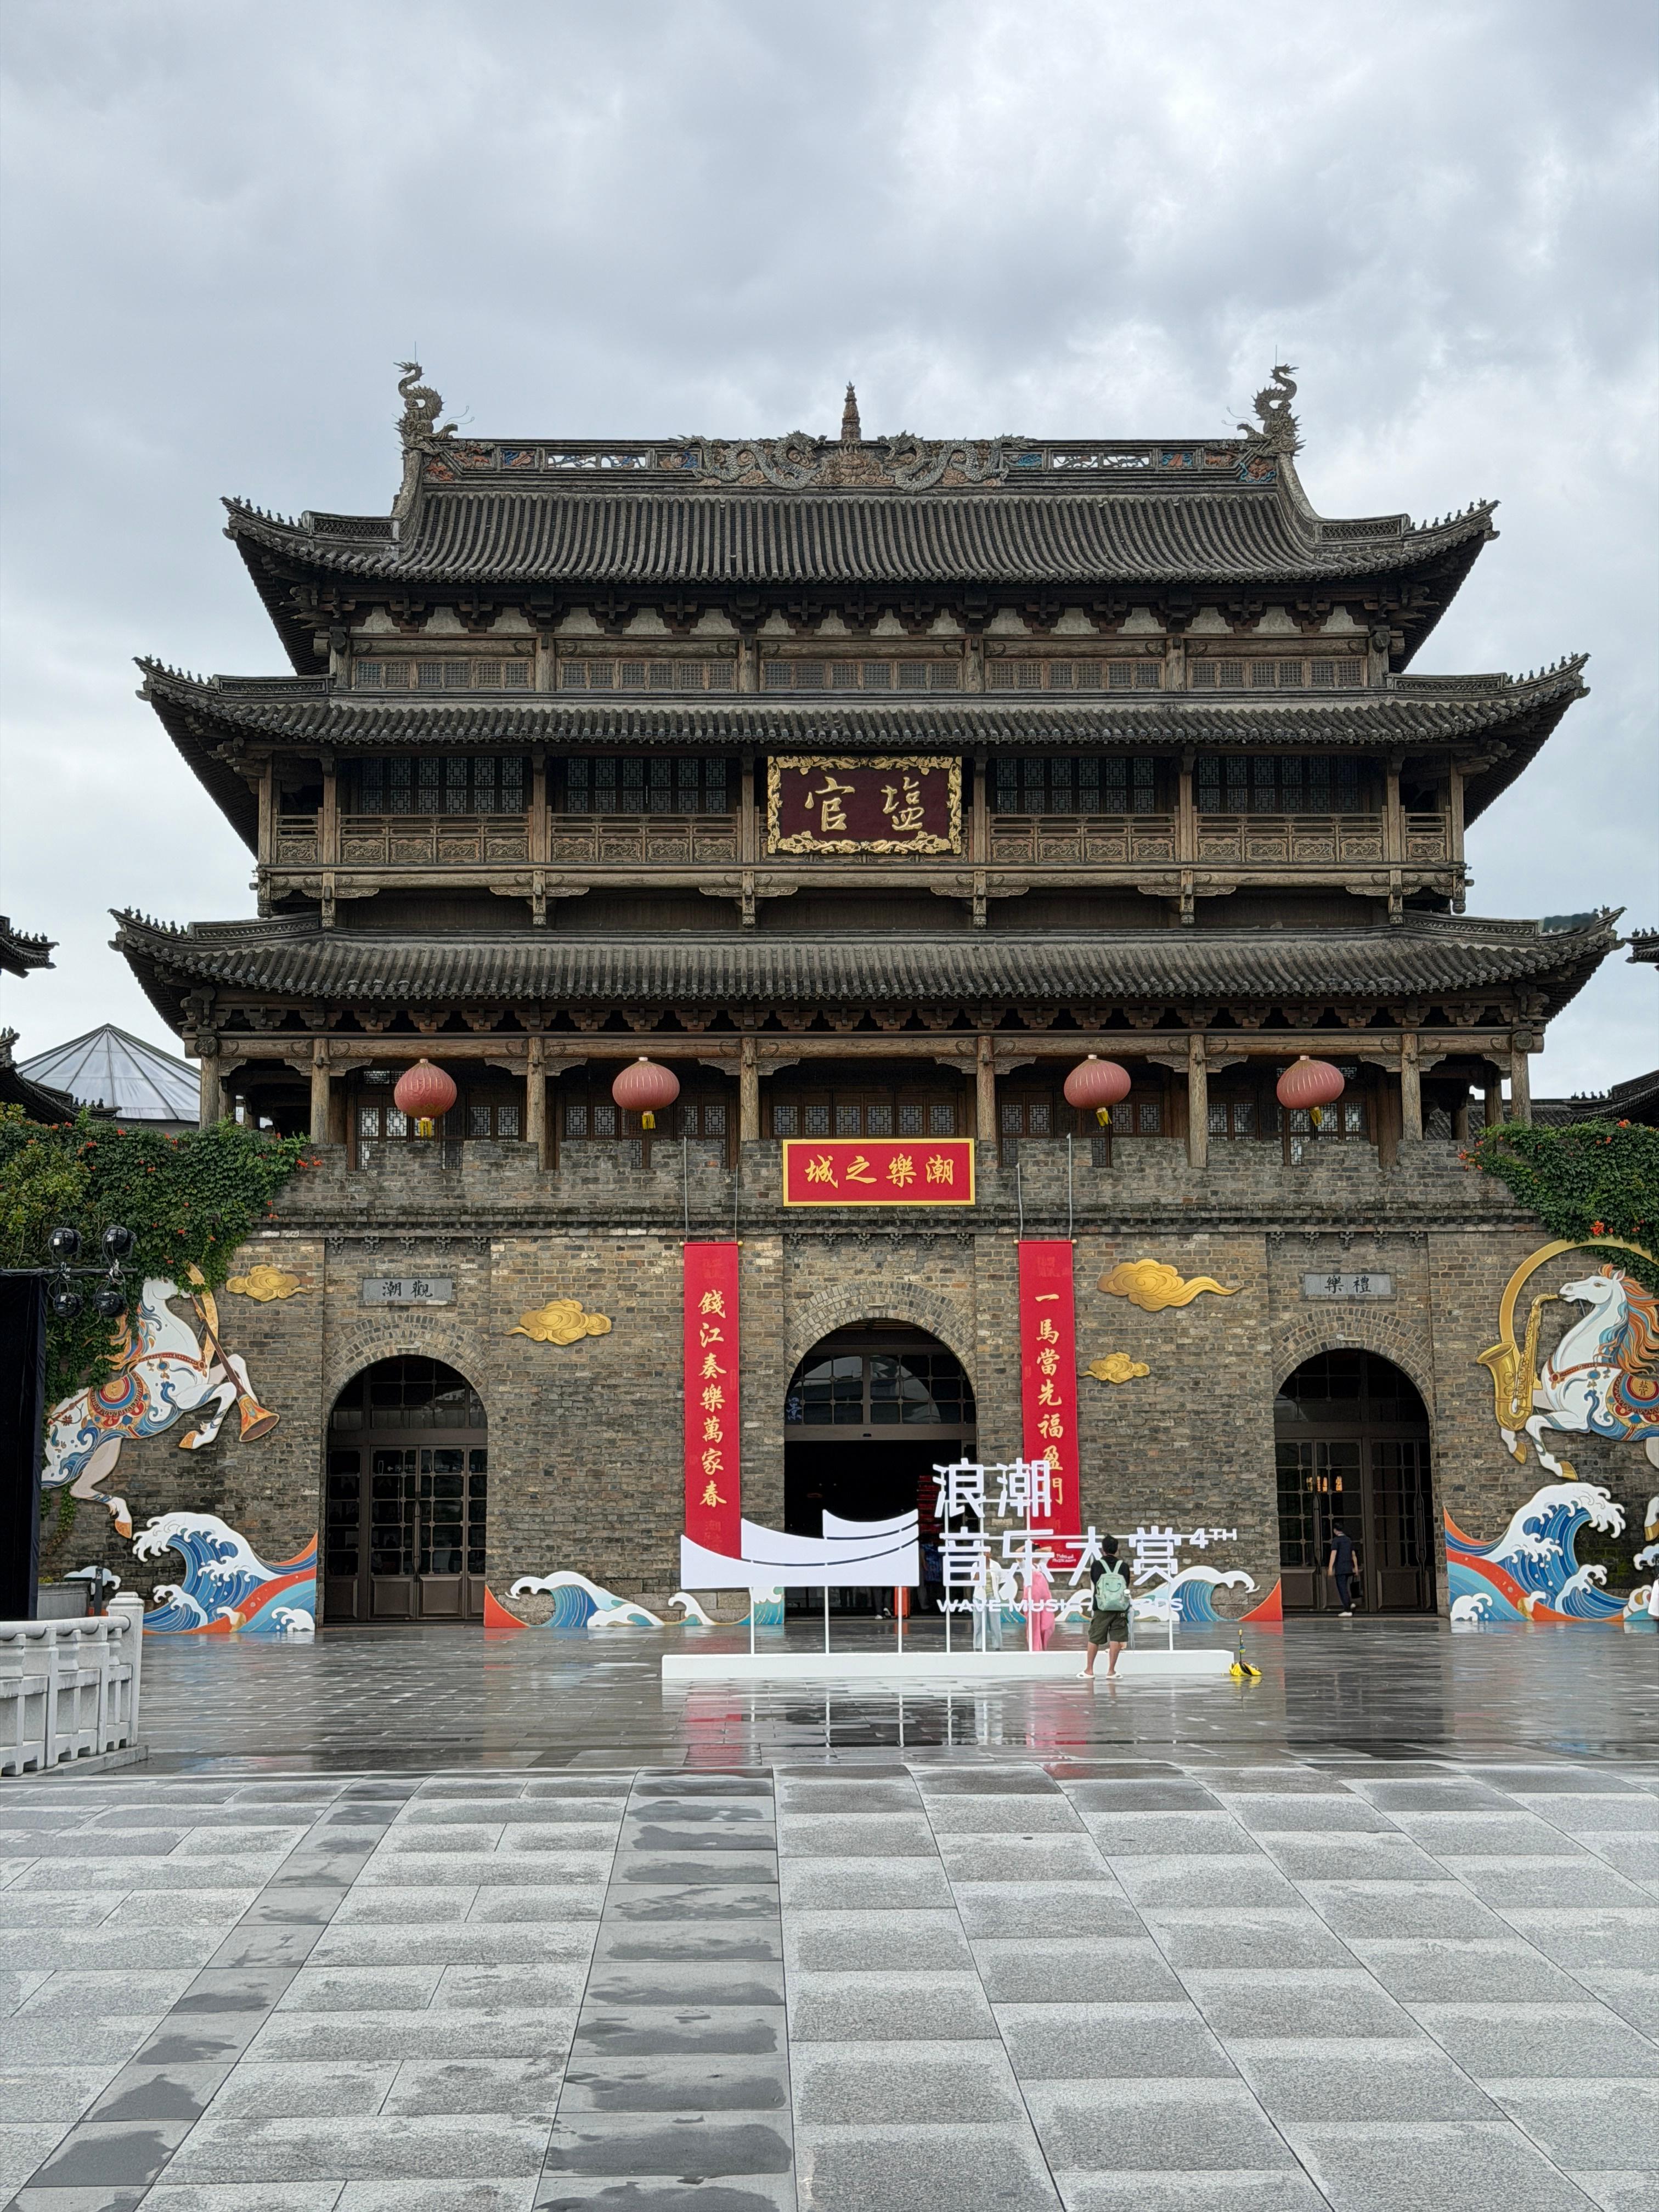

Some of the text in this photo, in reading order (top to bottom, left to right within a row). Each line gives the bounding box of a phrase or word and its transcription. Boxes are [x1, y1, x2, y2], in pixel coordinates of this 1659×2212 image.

[698, 1290, 727, 1508] 錢江奏樂萬家春
[933, 1458, 1051, 1517] 浪潮
[938, 1525, 1237, 1587] 音乐大赏 4TH
[936, 1599, 1002, 1612] WAVE
